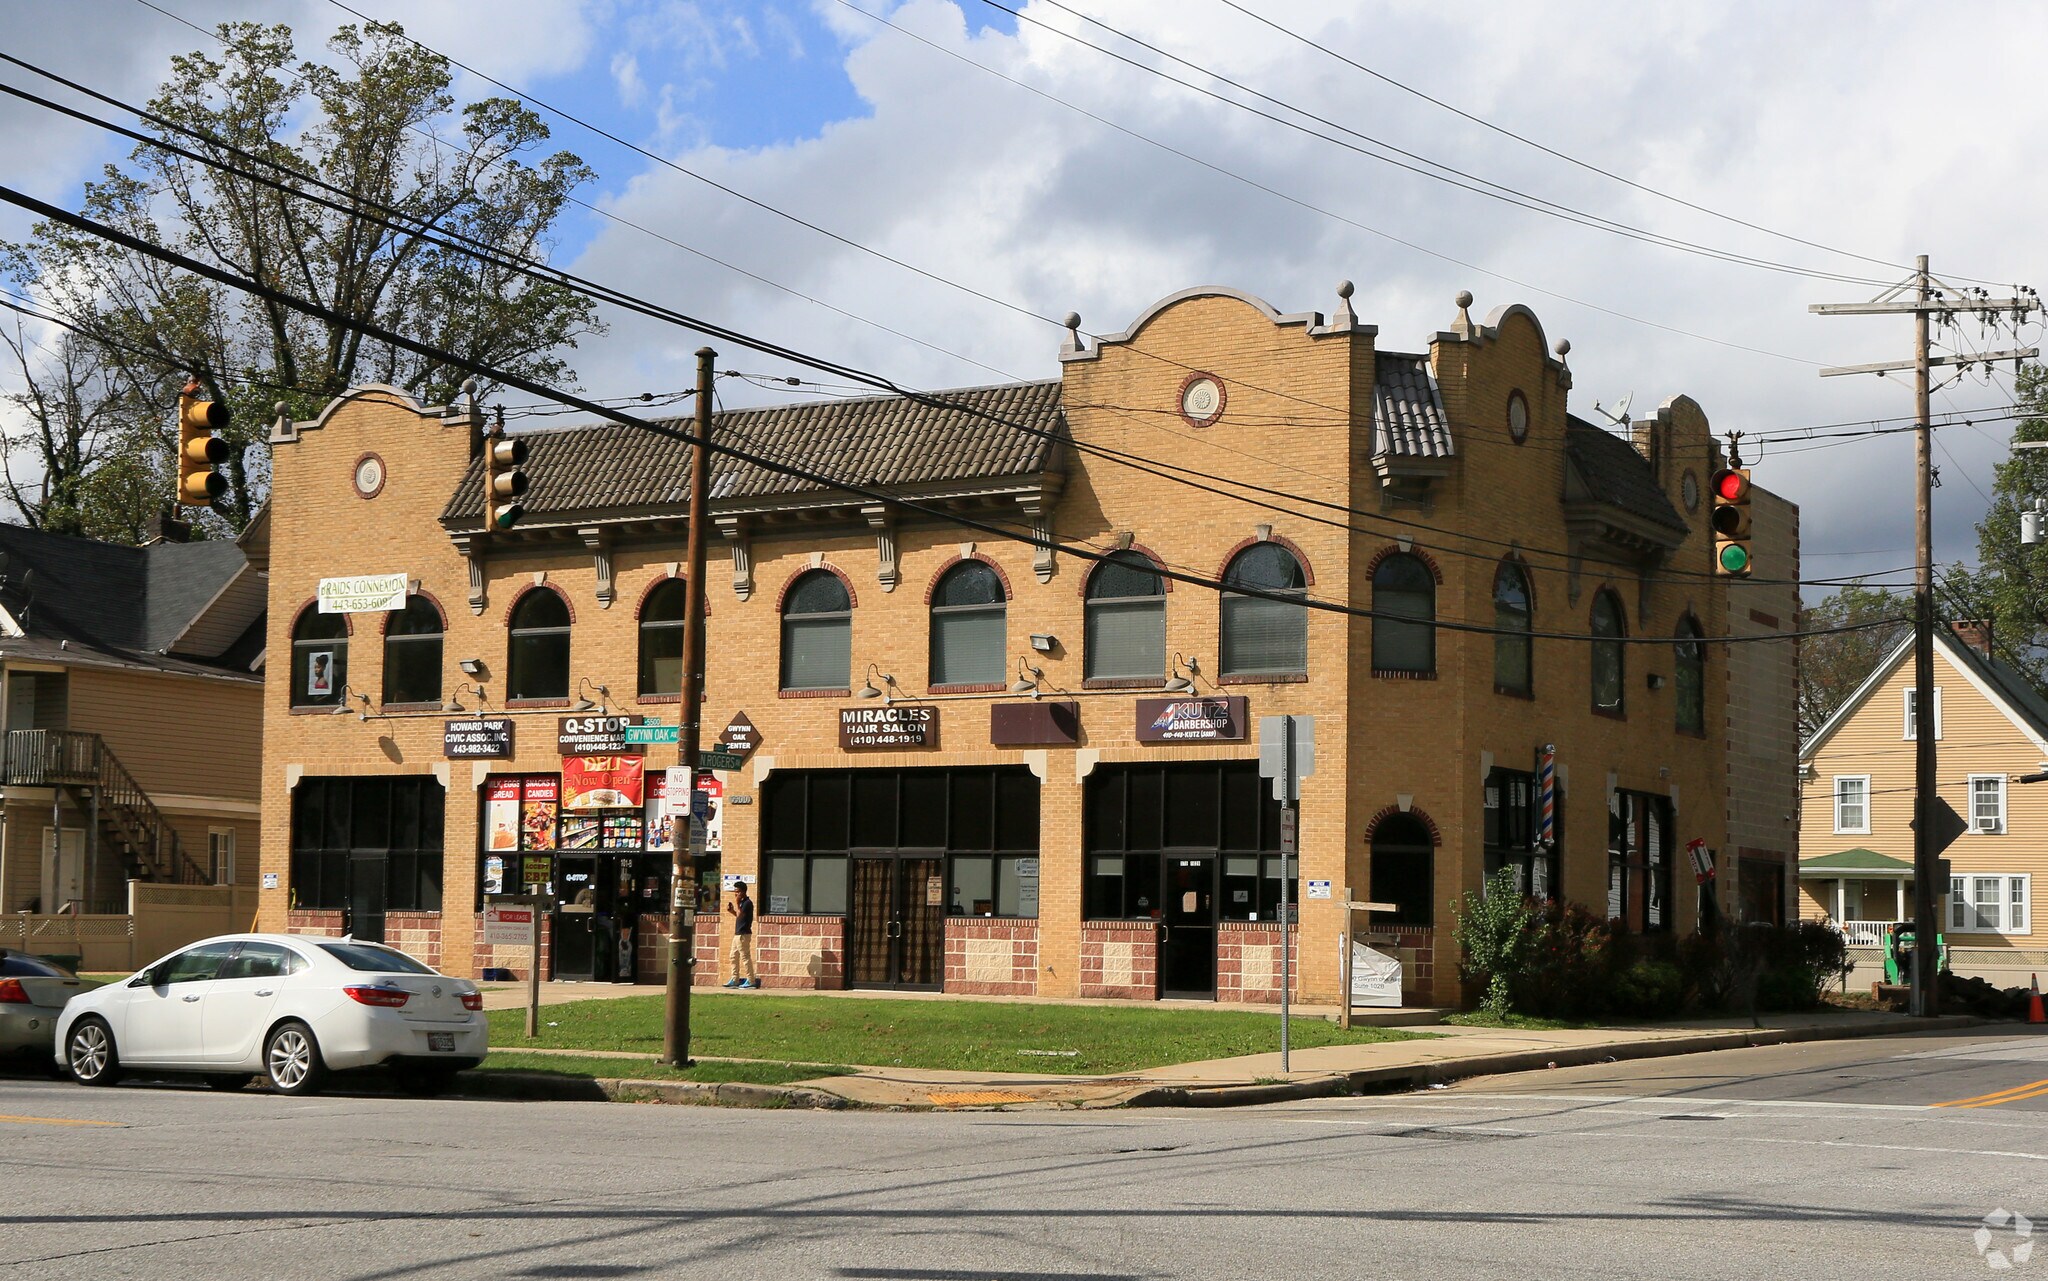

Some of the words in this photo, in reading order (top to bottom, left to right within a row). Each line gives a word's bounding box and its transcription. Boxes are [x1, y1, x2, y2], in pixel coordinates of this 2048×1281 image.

[354, 578, 405, 594] CONNEXION
[1173, 701, 1228, 719] KUTZ
[842, 708, 930, 723] MIRACLES
[450, 722, 483, 732] HOWARD
[484, 721, 504, 731] PARK
[565, 716, 630, 734] Q-STOP
[846, 724, 878, 733] HAIR
[882, 723, 926, 733] SALON
[1173, 719, 1228, 730] BARBERSHOP
[445, 733, 465, 743] CIVIC
[465, 733, 494, 743] ASSOC.
[494, 732, 509, 742] INC.
[559, 733, 609, 743] CONVENIENCE
[610, 733, 626, 742] MAR
[628, 728, 653, 741] GWYNN
[654, 728, 669, 741] OAK
[850, 735, 875, 745] (410)
[452, 744, 500, 754] 443-982-3422
[726, 742, 751, 750] CENTER
[584, 756, 621, 772] DELI
[525, 779, 550, 787] SNACKS
[550, 778, 556, 787] &
[572, 773, 598, 786] Now
[601, 772, 630, 787] Open
[673, 774, 683, 783] NO
[503, 780, 520, 788] EGGS
[493, 790, 514, 798] BREAD
[527, 789, 554, 798] CANDIES
[667, 787, 689, 796] STOPPING
[525, 871, 549, 882] EBT
[566, 873, 588, 882] Q-STOP
